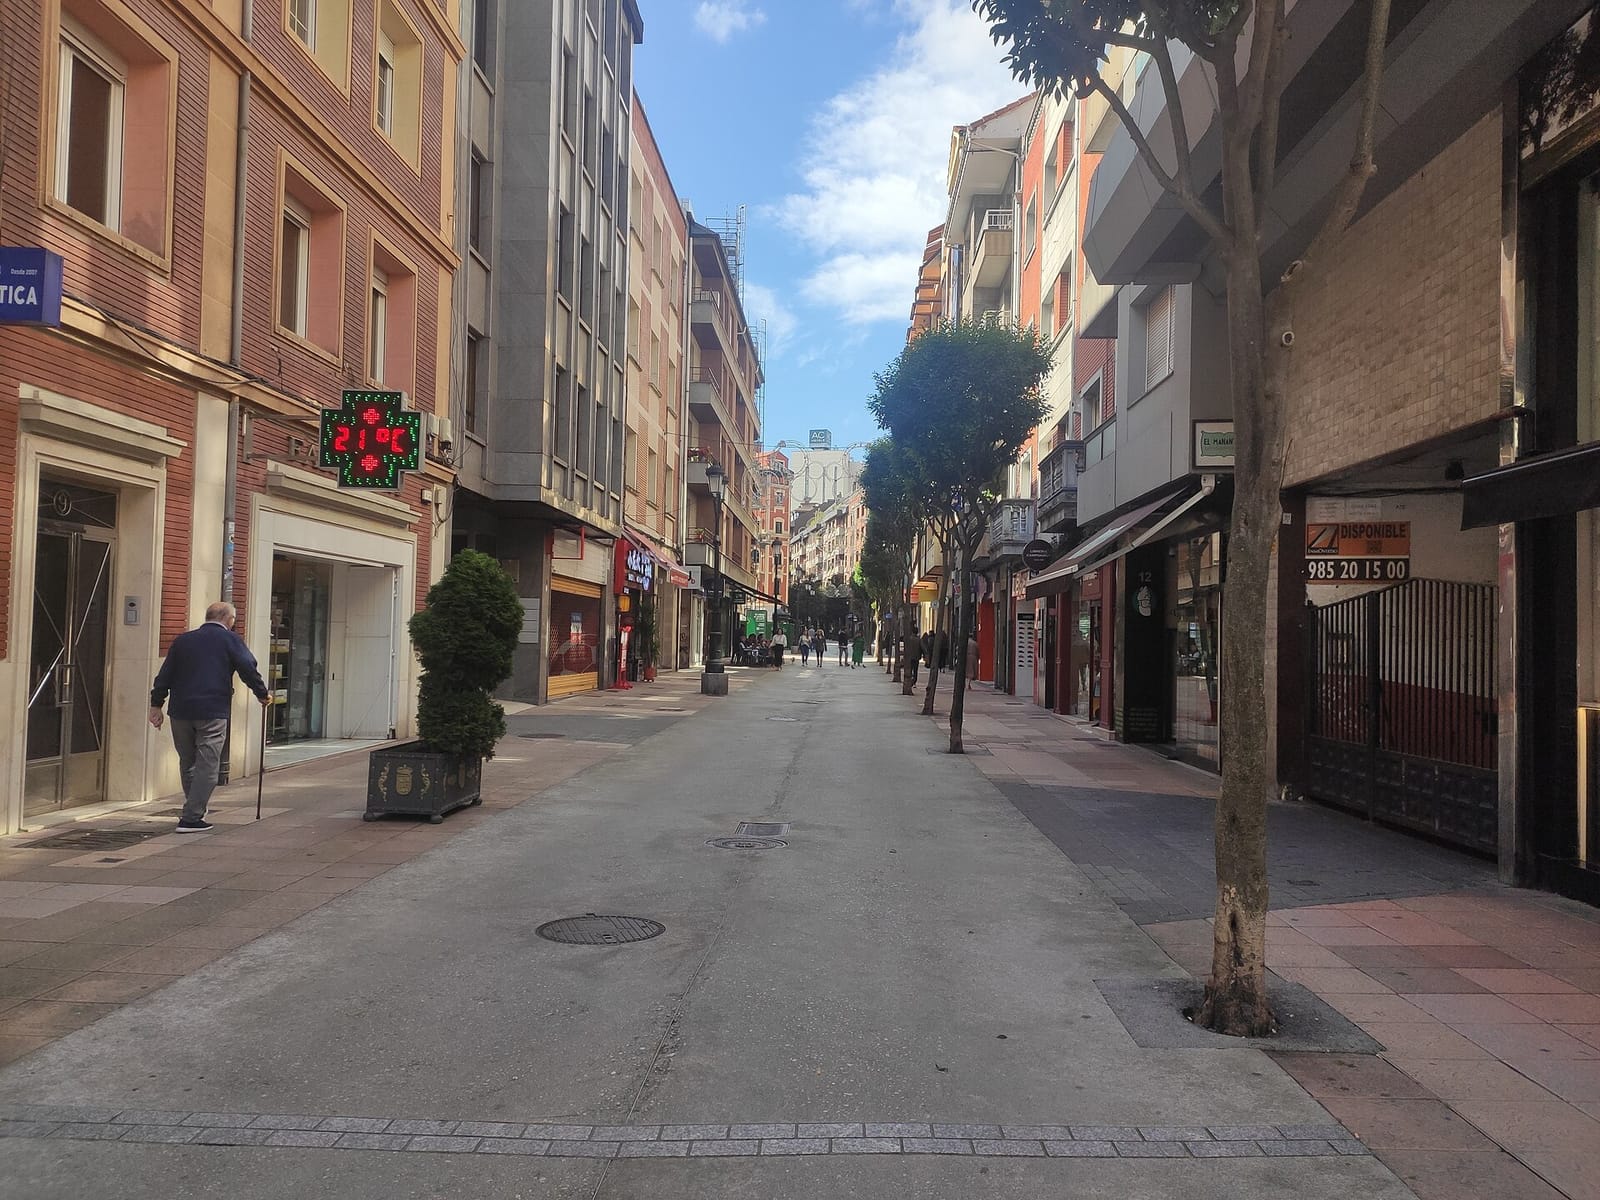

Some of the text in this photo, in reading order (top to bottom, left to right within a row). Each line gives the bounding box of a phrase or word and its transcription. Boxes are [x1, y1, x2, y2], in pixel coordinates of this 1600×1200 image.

[0, 285, 37, 305] TICA
[1341, 524, 1407, 539] DISPONIBLE
[1139, 571, 1152, 582] 12
[1308, 561, 1405, 579] 985 20 15 00
